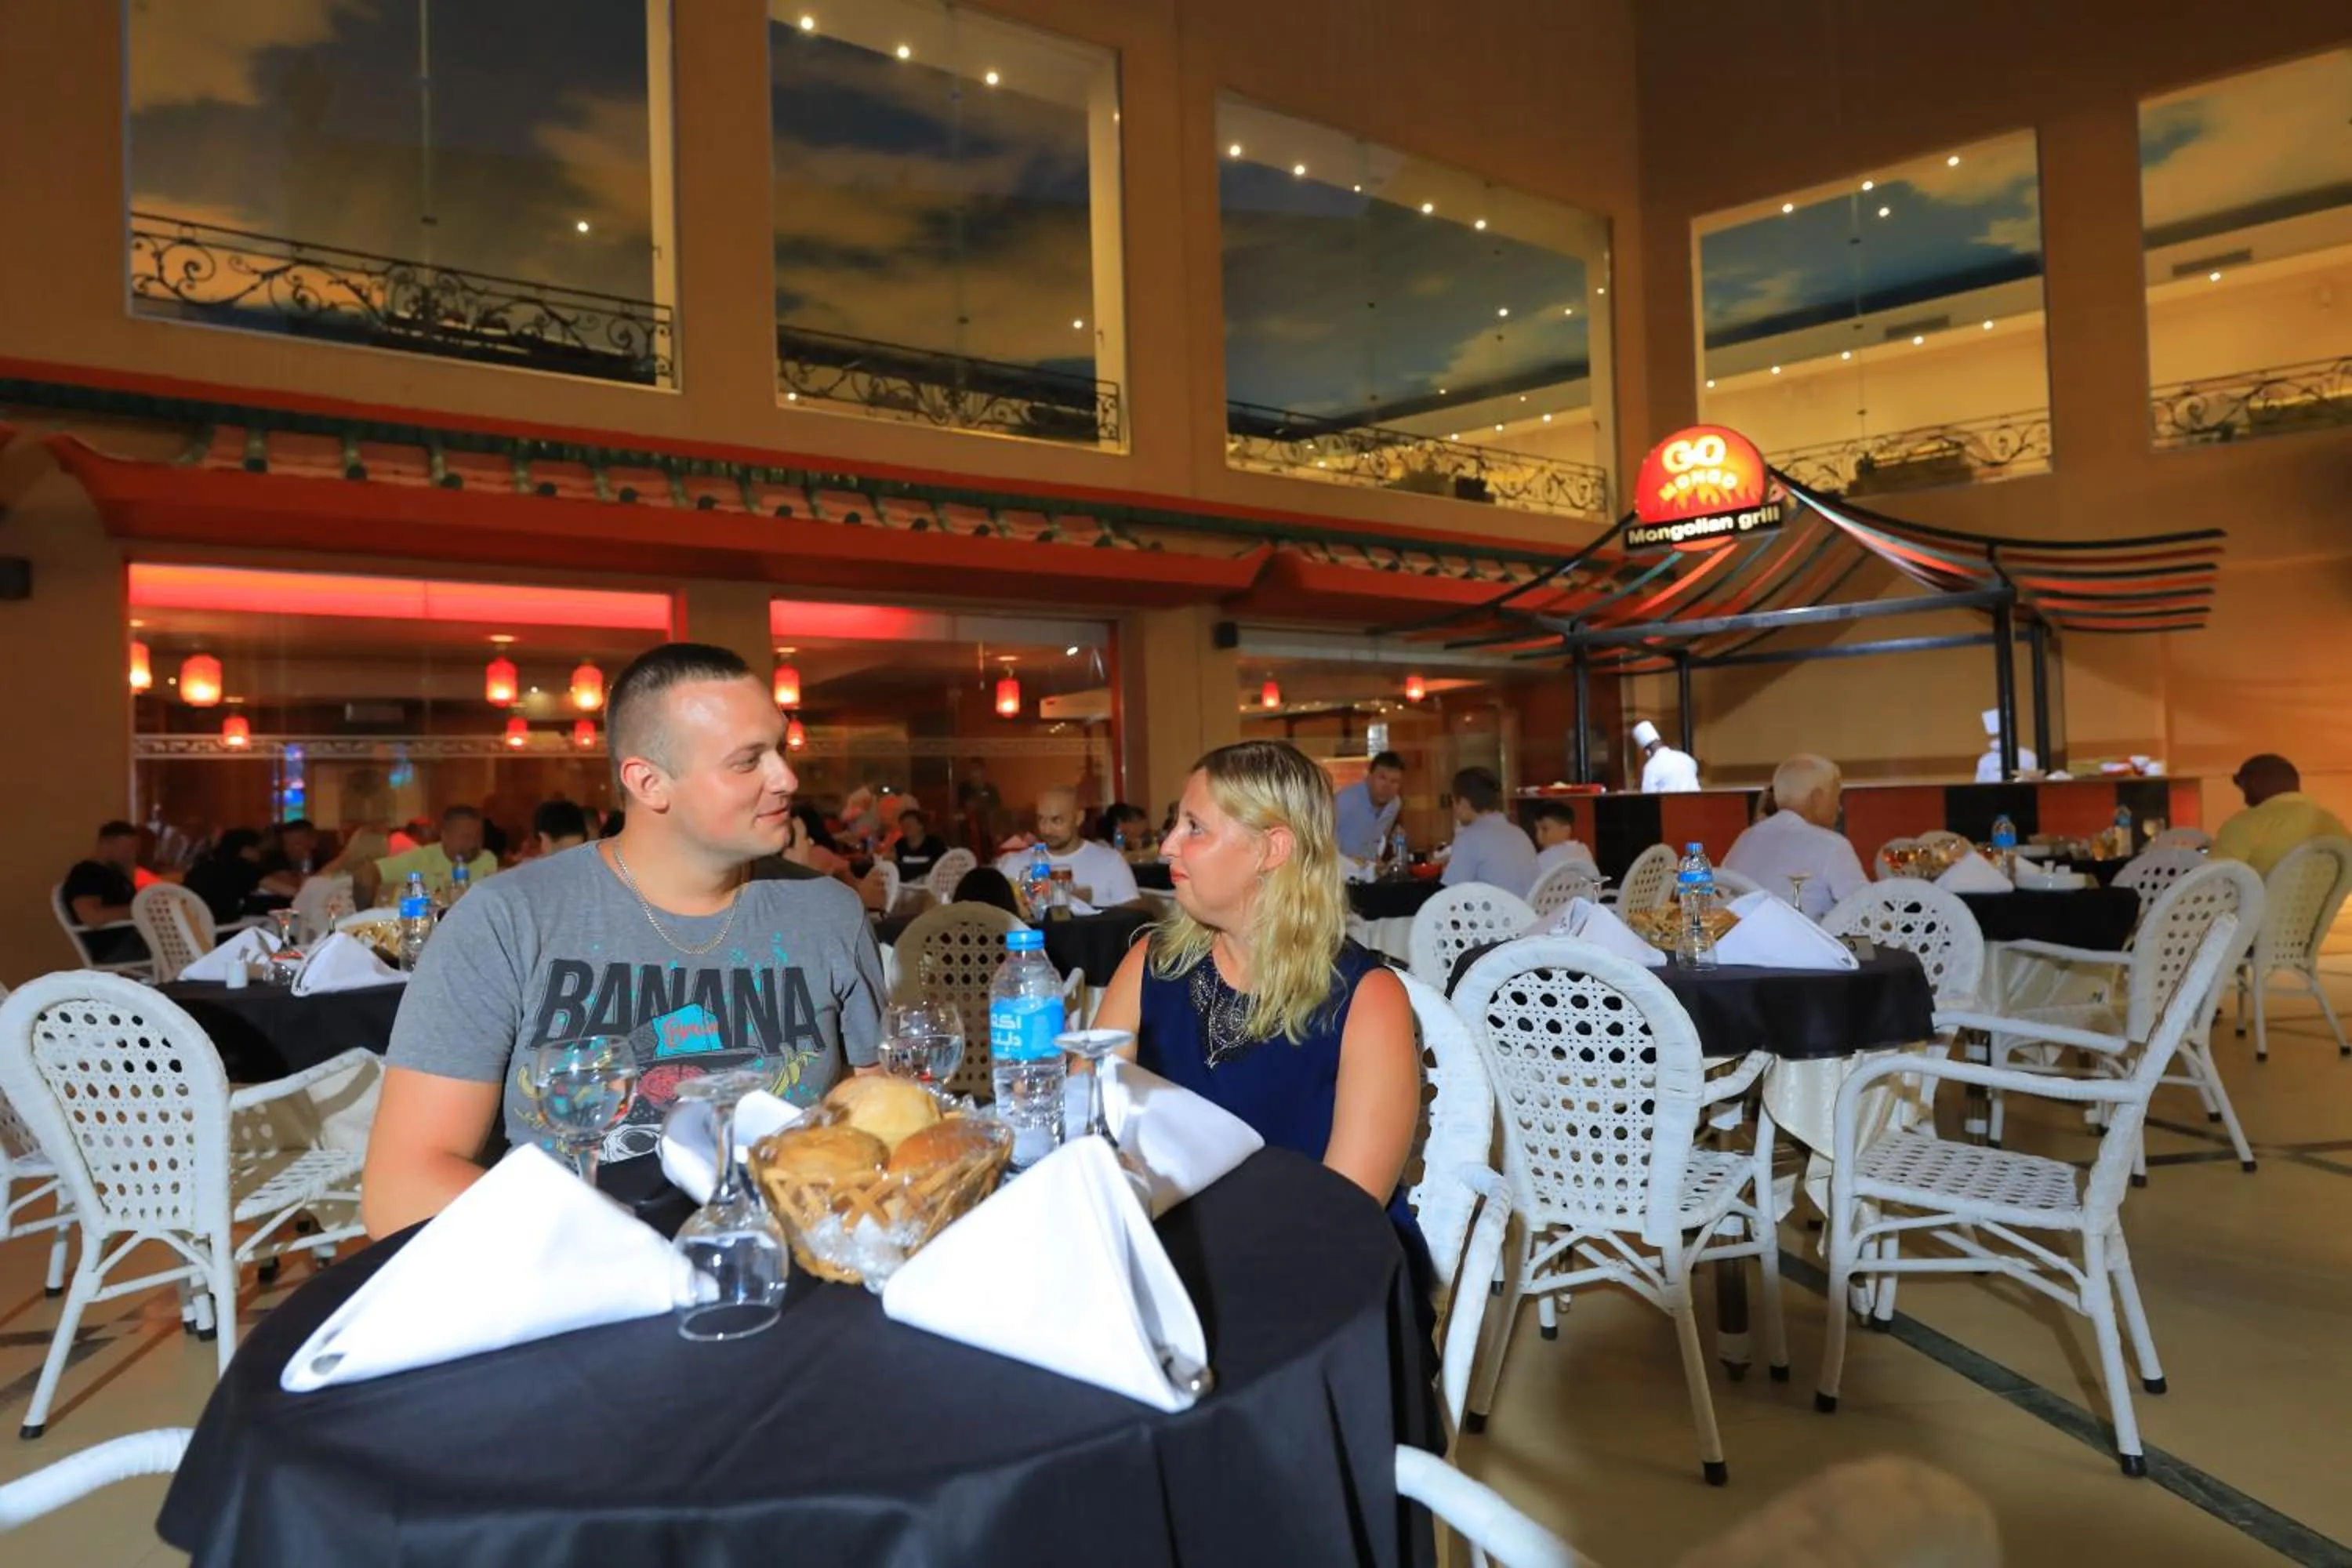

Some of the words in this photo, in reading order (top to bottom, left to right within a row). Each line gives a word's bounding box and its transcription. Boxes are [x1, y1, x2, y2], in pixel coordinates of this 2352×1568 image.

[1662, 434, 1726, 474] GO
[1628, 514, 1734, 544] Mongolian
[1738, 506, 1780, 530] grill
[528, 958, 827, 1056] BANANA
